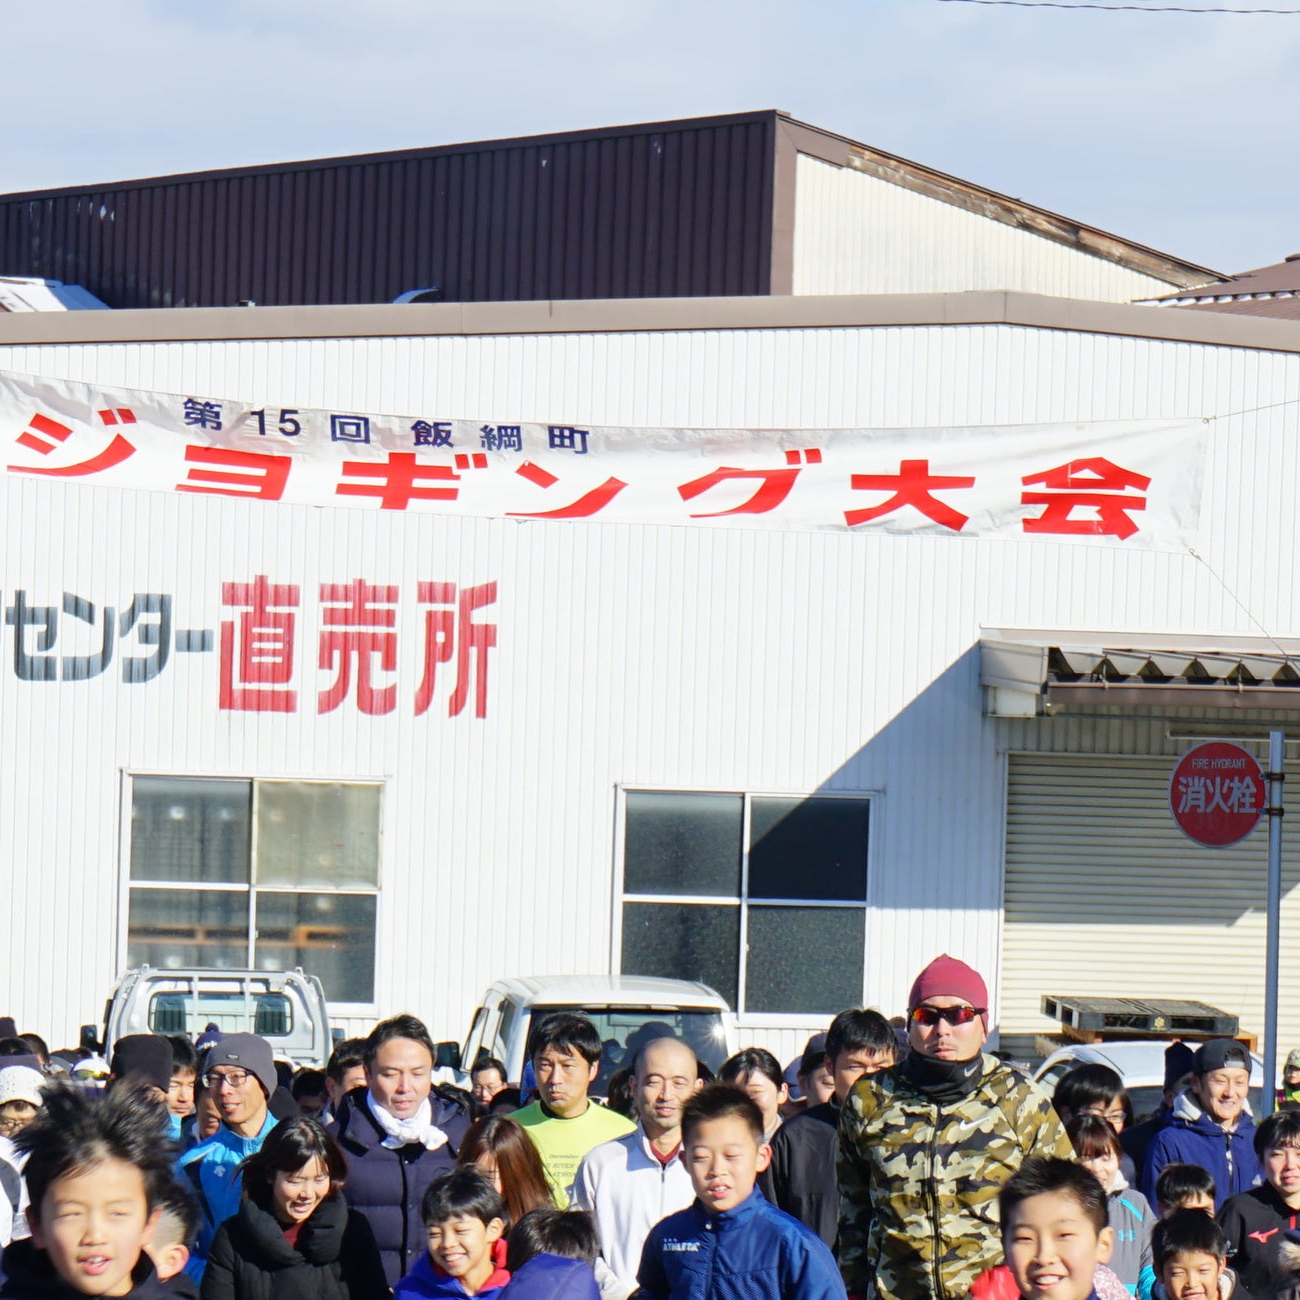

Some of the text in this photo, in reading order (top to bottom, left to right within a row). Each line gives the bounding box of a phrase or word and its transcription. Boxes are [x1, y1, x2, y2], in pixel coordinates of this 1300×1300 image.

[1191, 758, 1246, 769] FIRE HYDRANT
[1178, 776, 1258, 813] 消火栓
